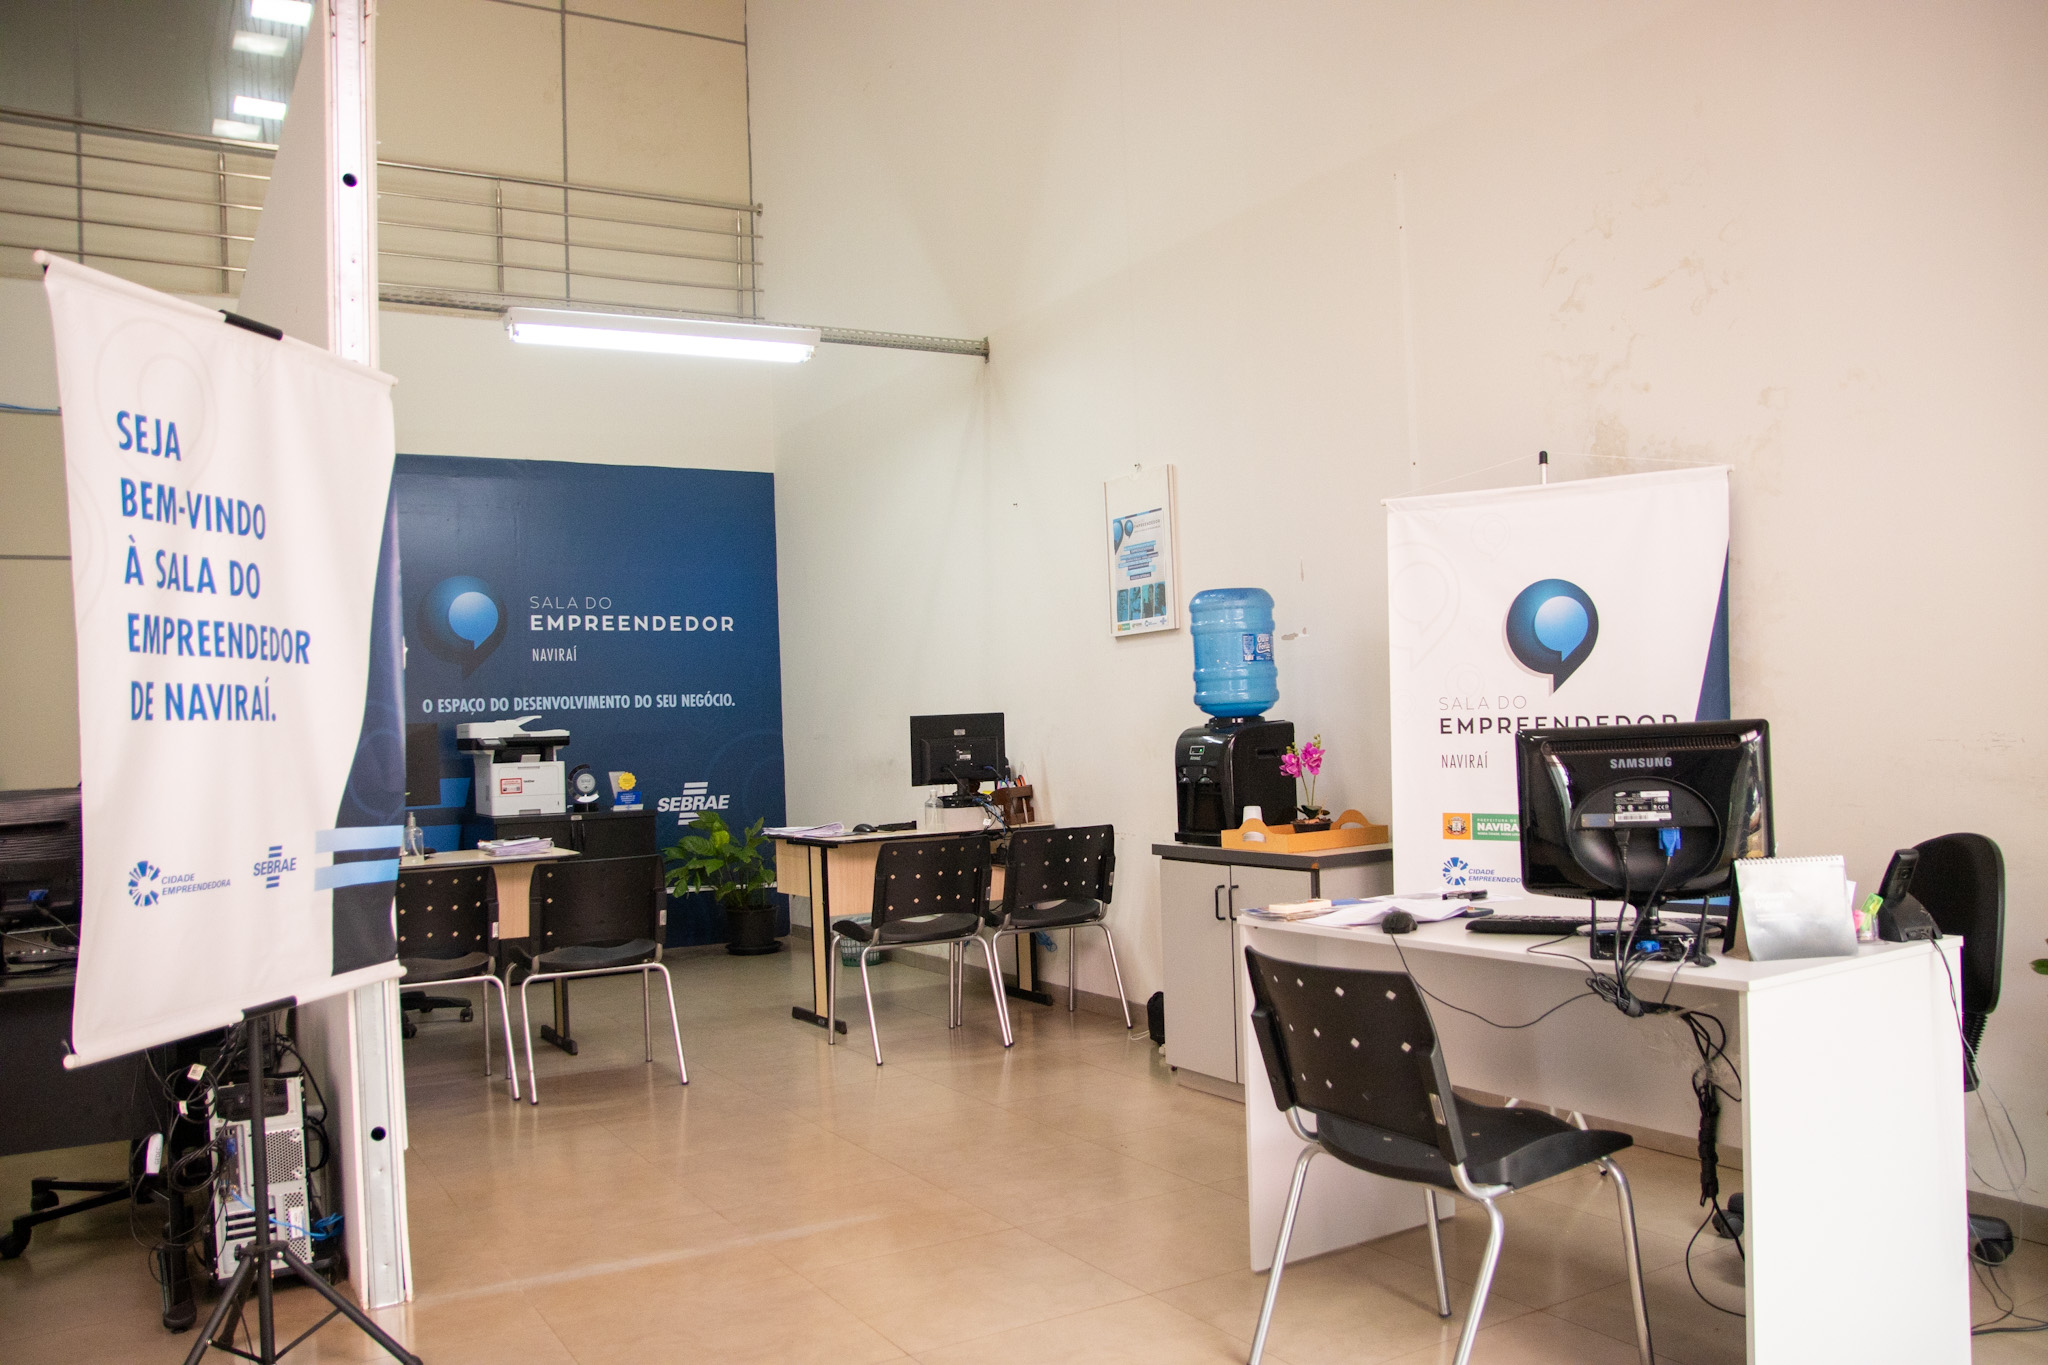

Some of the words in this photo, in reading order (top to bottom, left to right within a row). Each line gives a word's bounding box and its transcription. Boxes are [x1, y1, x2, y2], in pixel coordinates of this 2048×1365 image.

[116, 410, 181, 461] SEJA
[120, 477, 266, 541] BEM-VINDO
[124, 535, 144, 586] À
[156, 549, 217, 594] SALA
[229, 560, 261, 599] DO
[529, 595, 579, 610] SALA
[585, 596, 612, 610] DO
[530, 614, 734, 632] EMPREENDEDOR
[127, 612, 311, 664] EMPREENDEDOR
[532, 645, 577, 662] NAVIRAÍ
[130, 680, 154, 721] DE
[165, 677, 277, 722] NAVIRAÍ.
[422, 698, 433, 714] O
[437, 697, 486, 716] ESPAÇO
[490, 697, 510, 712] DO
[513, 694, 631, 711] DESENVOLVIMENTO
[634, 694, 653, 709] DO
[655, 694, 677, 708] SEU
[681, 691, 736, 708] NEGÓCIO.
[1438, 696, 1490, 711] SALA
[1498, 695, 1527, 710] DO
[1441, 751, 1489, 769] NAVIRAÍ
[1609, 756, 1673, 769] SAMSUNG
[657, 794, 731, 813] SEBRAE
[1477, 822, 1519, 832] NAVIRA
[253, 857, 297, 877] SEBRAE
[161, 873, 195, 885] CIDADE
[162, 879, 231, 896] EMPREENDEDORA
[1468, 875, 1522, 883] EMPREENDEDO
